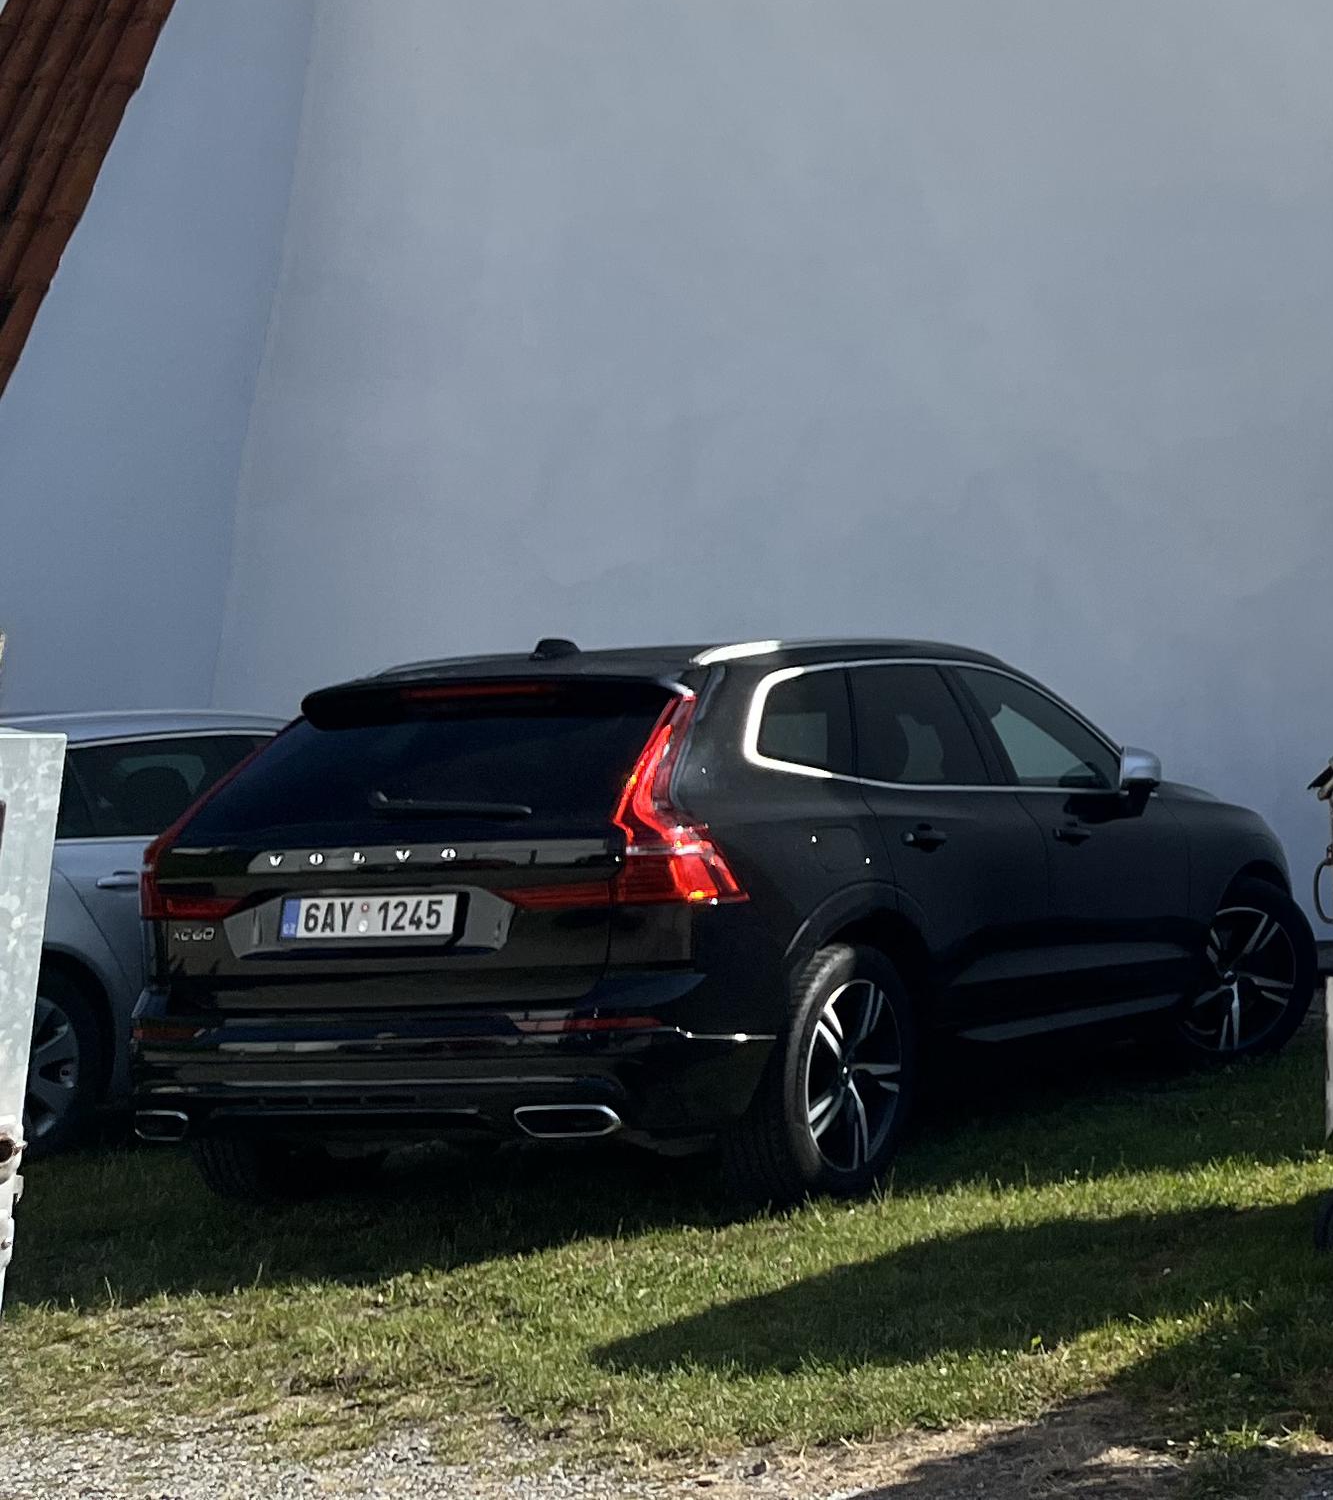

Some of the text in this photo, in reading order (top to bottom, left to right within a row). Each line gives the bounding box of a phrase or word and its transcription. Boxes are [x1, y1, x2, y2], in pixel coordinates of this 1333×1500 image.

[268, 848, 457, 867] VOLVO
[304, 901, 354, 933] 6AY
[378, 900, 443, 931] 1245
